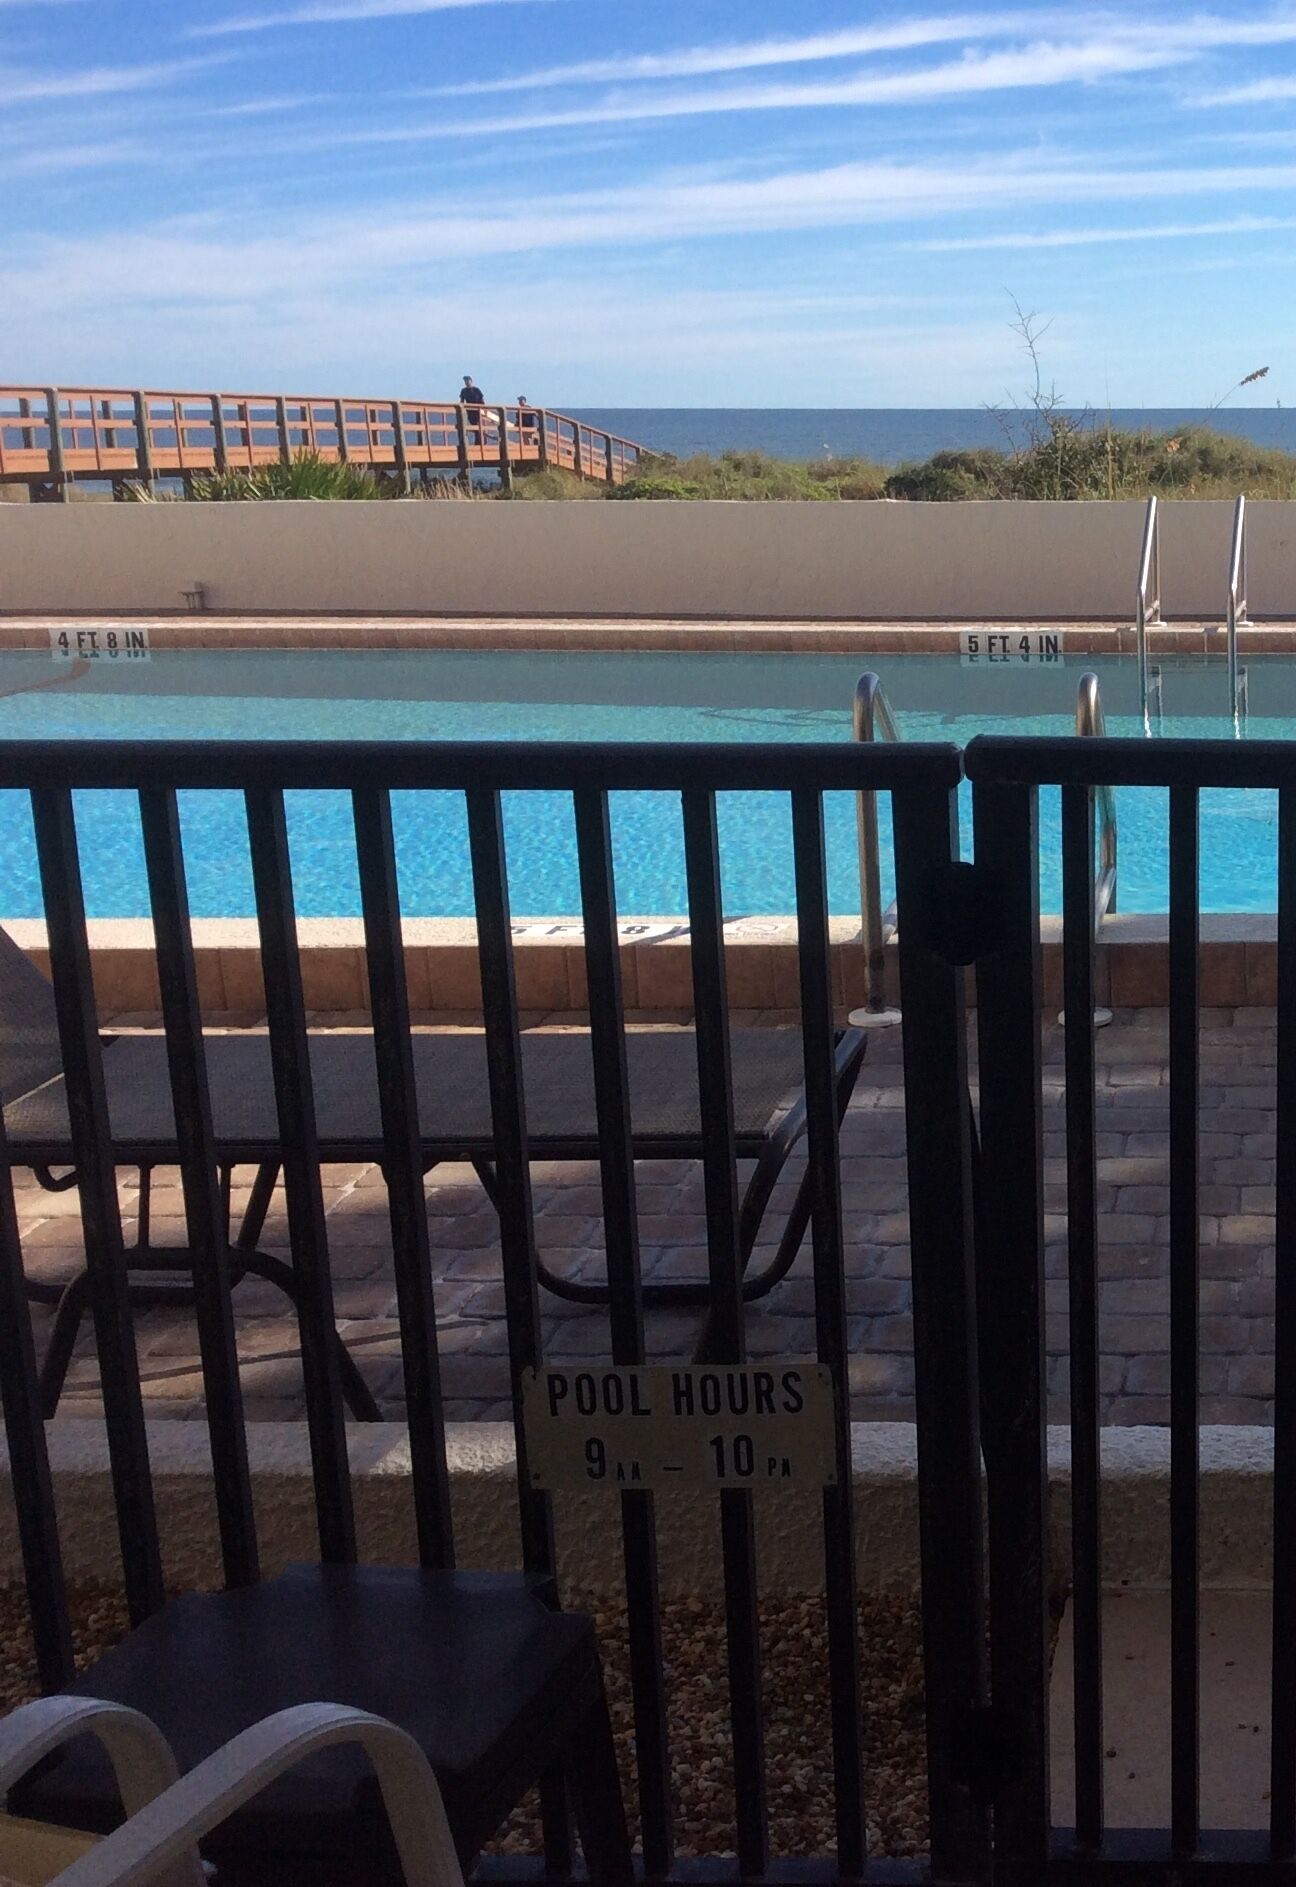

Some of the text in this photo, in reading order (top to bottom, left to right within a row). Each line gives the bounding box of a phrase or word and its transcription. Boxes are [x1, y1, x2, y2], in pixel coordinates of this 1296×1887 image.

[58, 631, 69, 648] 4
[106, 631, 118, 648] 8
[968, 635, 979, 653] 5
[1018, 635, 1031, 653] 4
[621, 925, 651, 935] 8
[547, 1371, 804, 1416] POOL HOURS
[709, 1434, 755, 1478] 10
